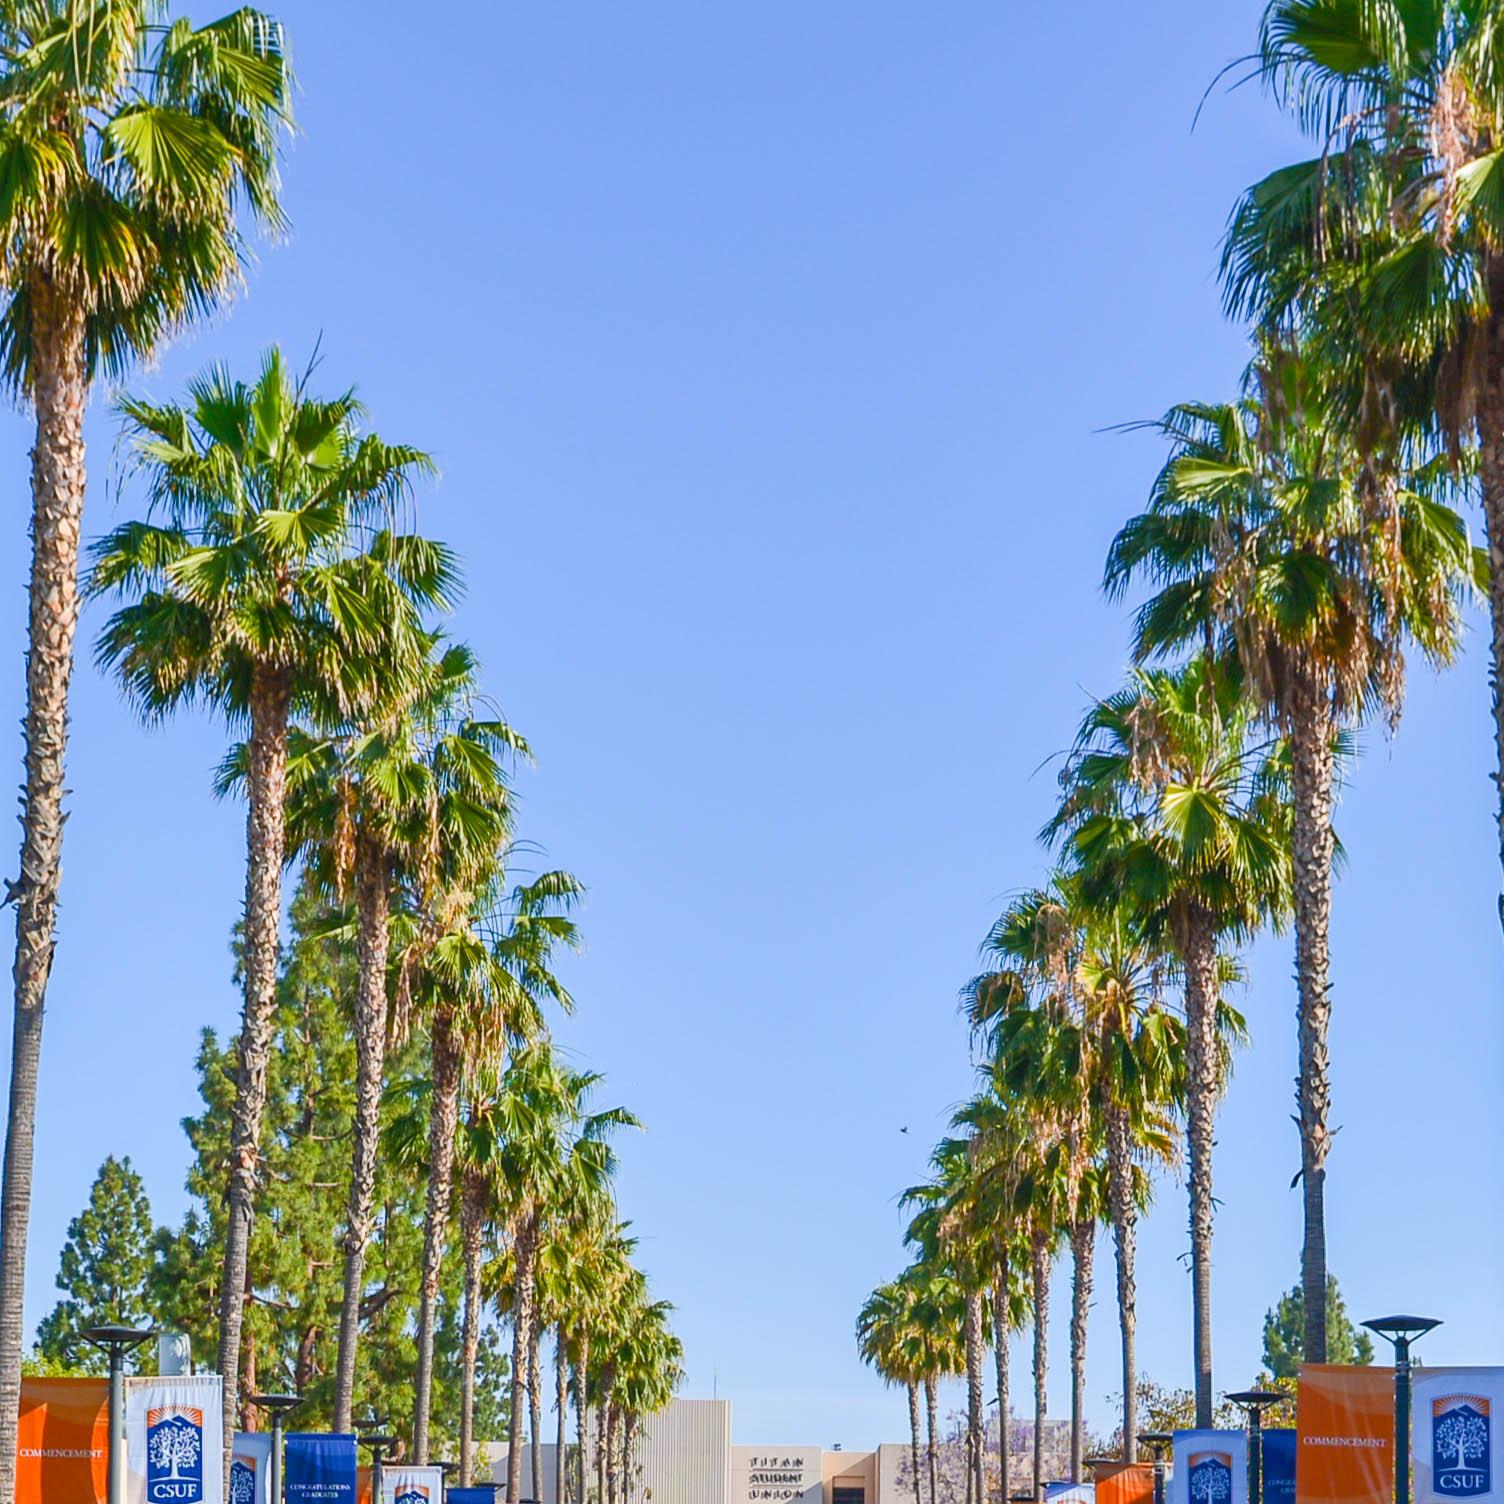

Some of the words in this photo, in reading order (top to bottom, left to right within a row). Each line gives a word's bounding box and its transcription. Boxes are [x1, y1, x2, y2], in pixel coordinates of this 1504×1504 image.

[1303, 1436, 1386, 1448] COMMENCEMENT
[19, 1449, 104, 1458] COMMENCEMENT
[750, 1457, 804, 1467] TITAN
[749, 1473, 803, 1484] STUDENT
[1439, 1474, 1485, 1489] CSUF
[153, 1483, 198, 1498] CSUF
[749, 1489, 804, 1500] UNION
